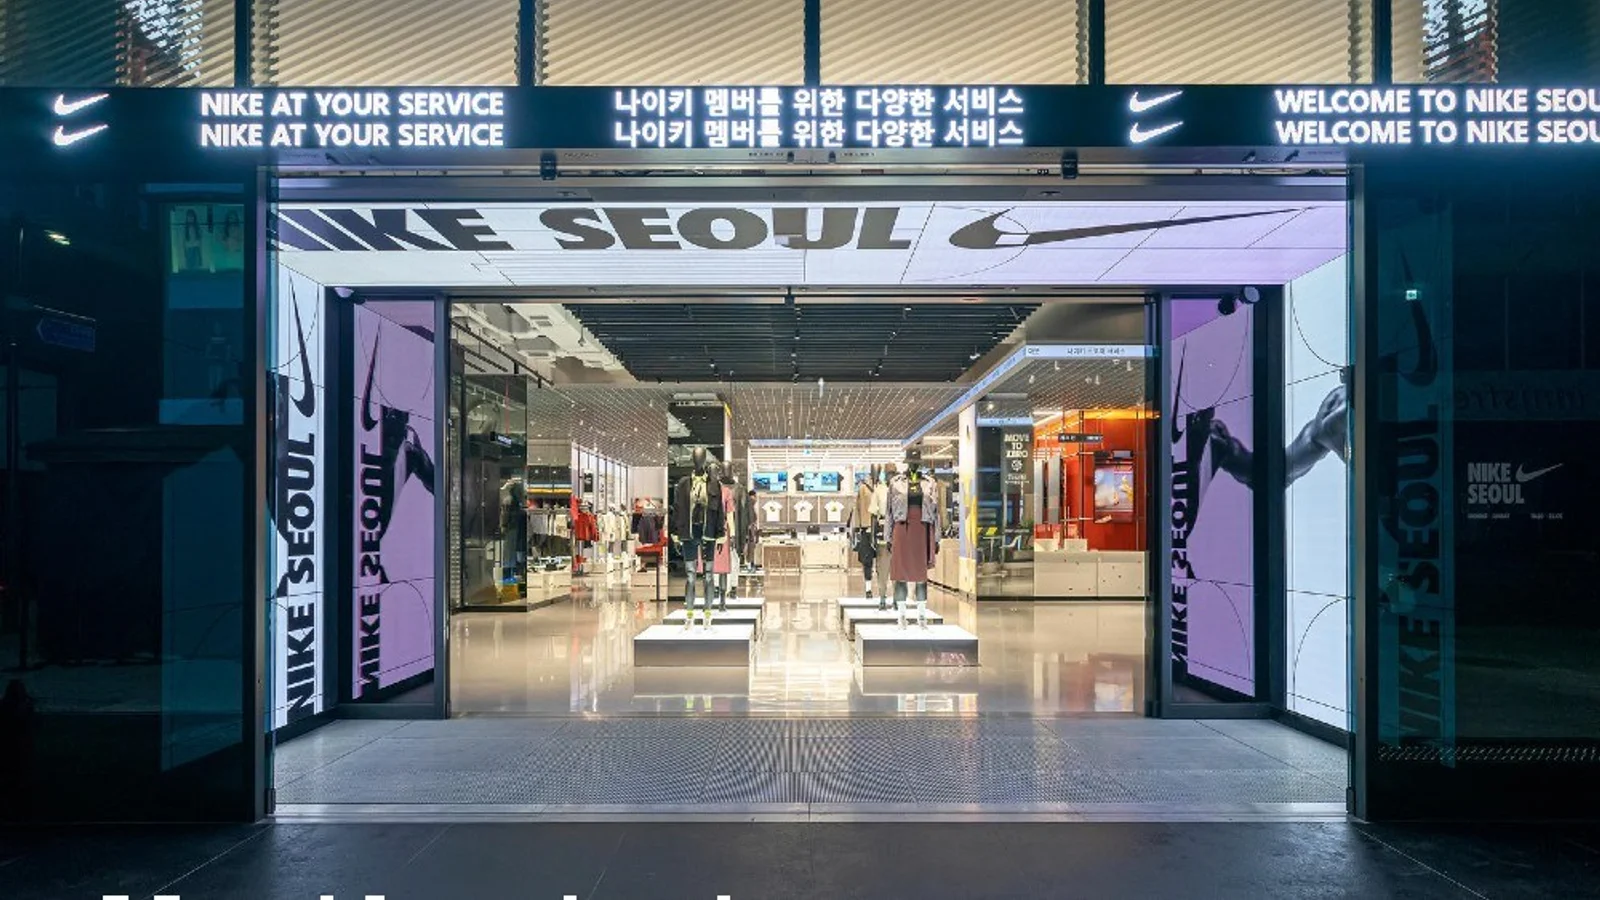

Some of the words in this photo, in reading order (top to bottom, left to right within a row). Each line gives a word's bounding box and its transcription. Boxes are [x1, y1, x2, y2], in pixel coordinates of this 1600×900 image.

[201, 92, 263, 116] NIKE
[271, 92, 307, 116] AT
[314, 92, 390, 116] YOUR
[398, 91, 503, 116] SERVICE
[615, 88, 692, 117] 나이키
[704, 87, 783, 117] 멤버를
[793, 88, 846, 117] 위한
[856, 88, 935, 117] 다양한
[944, 87, 1023, 116] 서비스
[1275, 88, 1411, 113] WELCOME
[1418, 88, 1457, 113] TO
[1466, 88, 1528, 113] NIKE
[201, 123, 263, 147] NIKE
[271, 123, 307, 147] AT
[314, 123, 390, 147] YOUR
[398, 122, 503, 147] SERVICE
[615, 119, 692, 148] 나이키
[704, 118, 783, 148] 멤버를
[793, 119, 846, 148] 위한
[856, 119, 935, 148] 다양한
[944, 118, 1023, 147] 서비스
[1275, 120, 1411, 144] WELCOME
[1418, 120, 1457, 144] TO
[1466, 120, 1529, 144] NIKE
[540, 207, 911, 250] SEOUL
[1467, 462, 1511, 483] NIKE
[1467, 484, 1525, 505] SEOUL
[287, 433, 315, 583] SEOUL
[287, 602, 315, 724] NIKE
